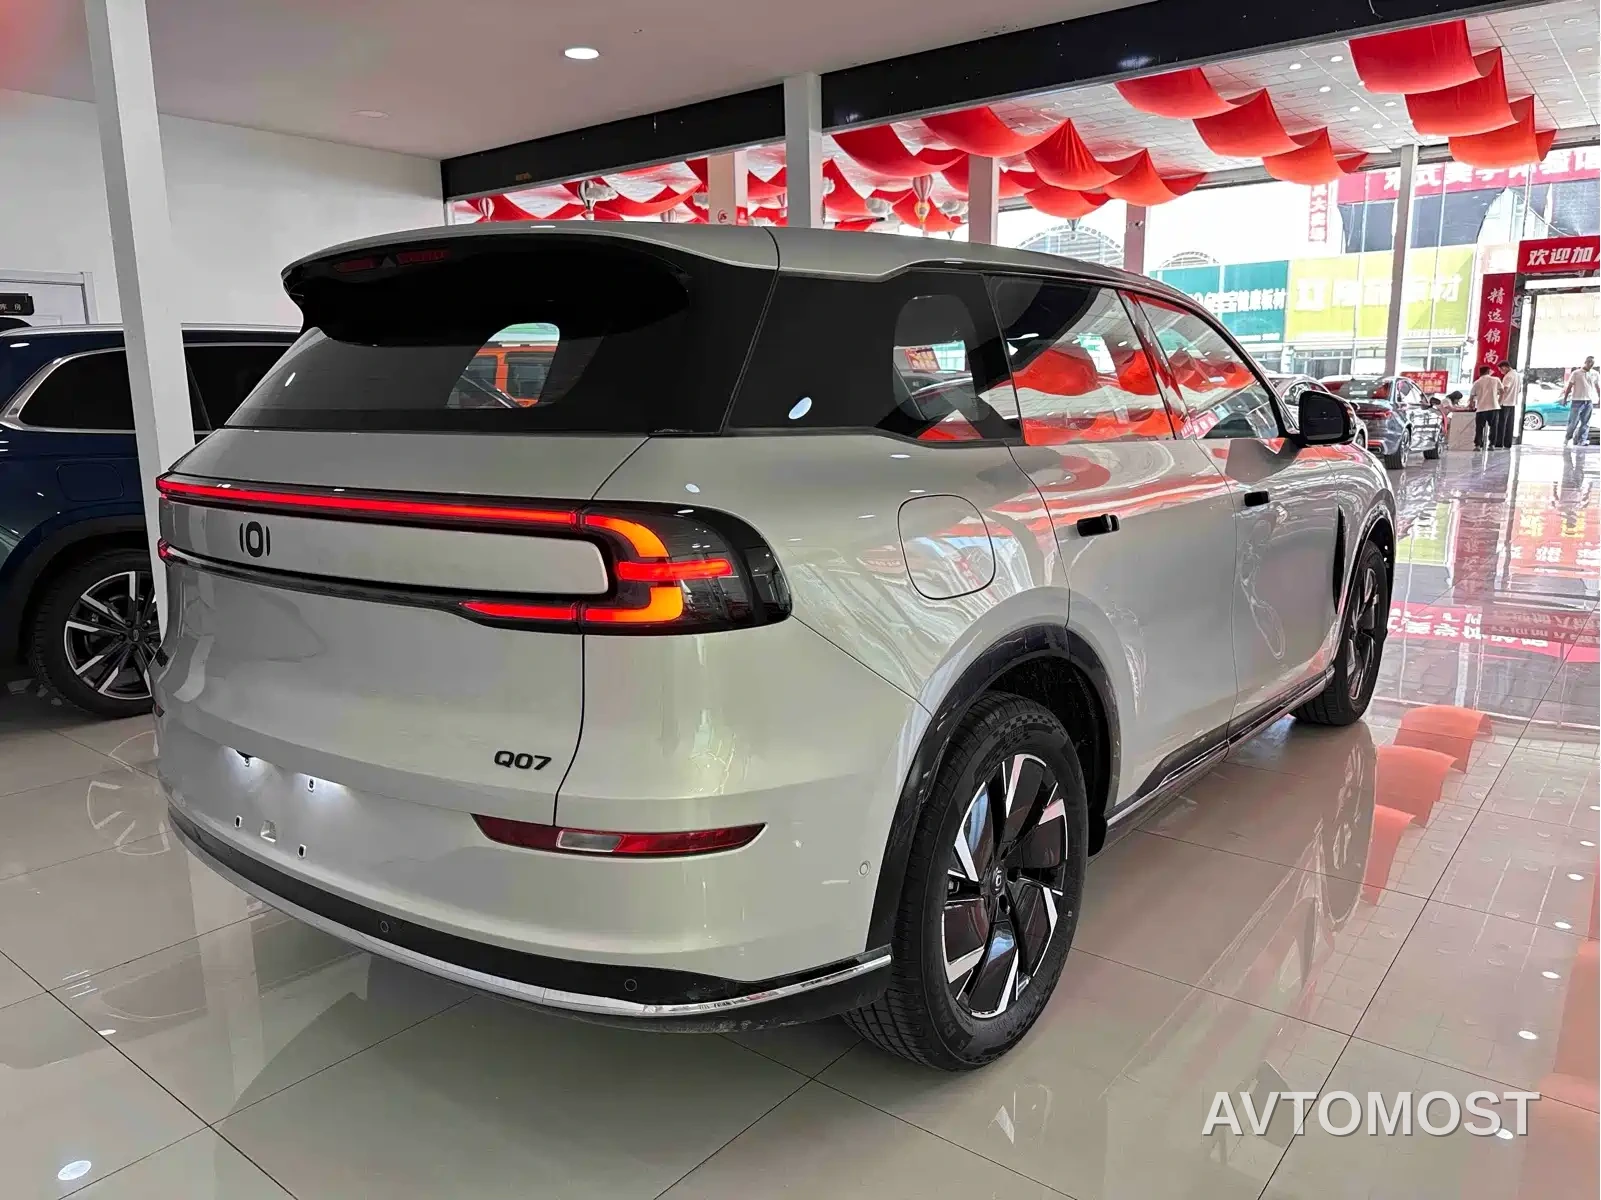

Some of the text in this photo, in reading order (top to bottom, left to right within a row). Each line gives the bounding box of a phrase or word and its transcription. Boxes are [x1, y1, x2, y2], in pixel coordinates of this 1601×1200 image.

[1527, 246, 1600, 266] 欢迎加
[494, 751, 552, 770] Q07
